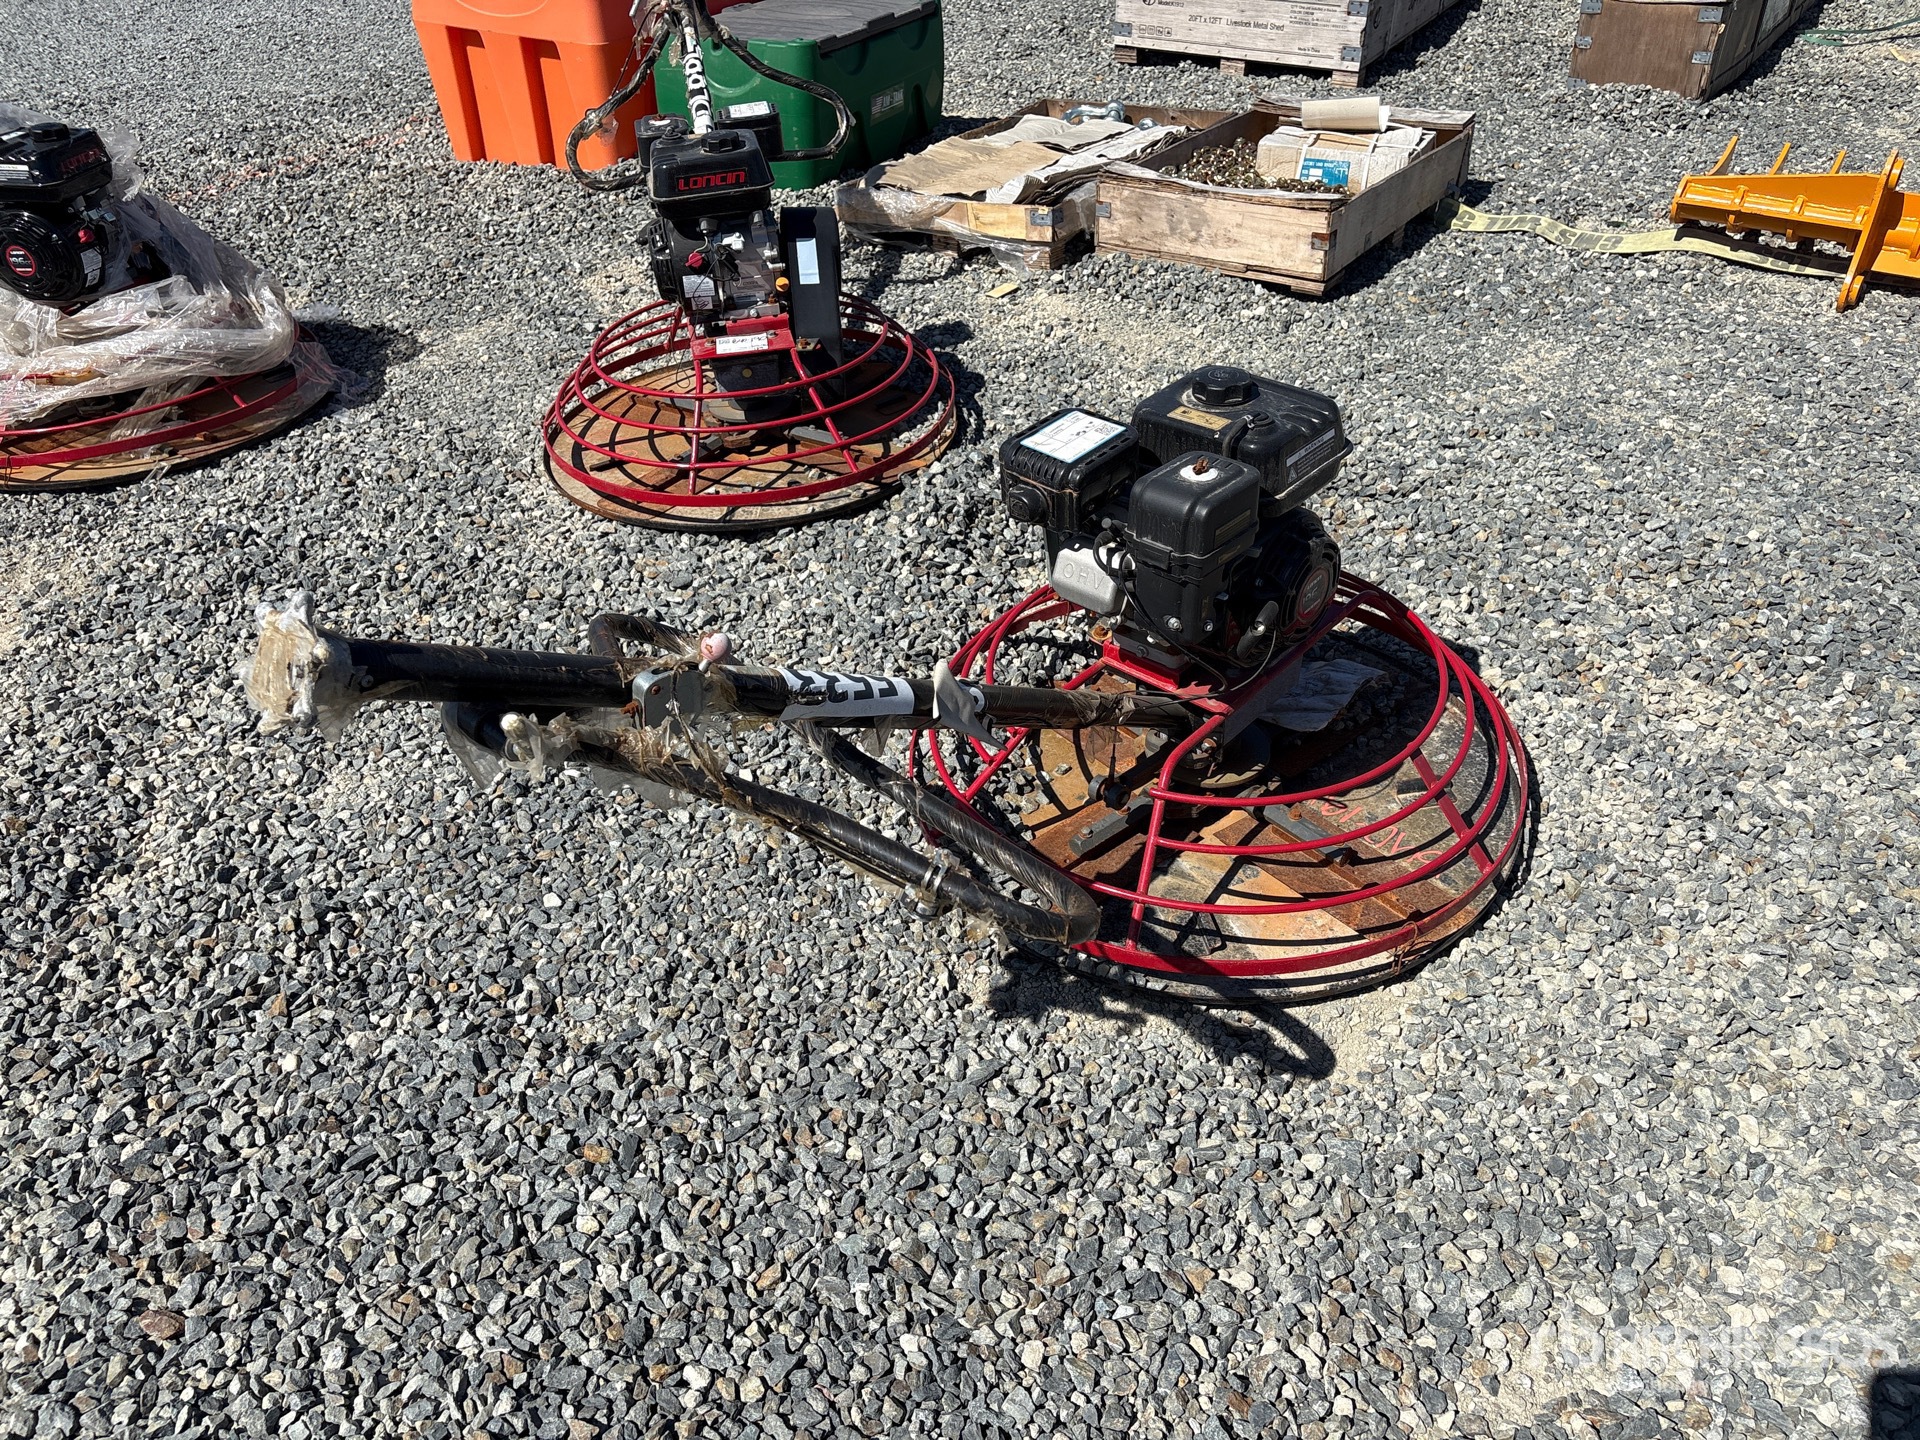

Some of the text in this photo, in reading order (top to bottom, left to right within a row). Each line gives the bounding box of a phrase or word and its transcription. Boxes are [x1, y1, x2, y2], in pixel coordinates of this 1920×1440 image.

[1188, 15, 1203, 23] 20FT
[1208, 17, 1222, 25] 12FT
[1225, 18, 1251, 29] Livestock
[1253, 20, 1268, 30] Metal
[1269, 22, 1285, 31] Shed
[678, 171, 746, 191] LONCIN
[1555, 228, 1624, 251] CMS
[1304, 436, 1324, 453] WARNING
[1063, 562, 1104, 590] OHV
